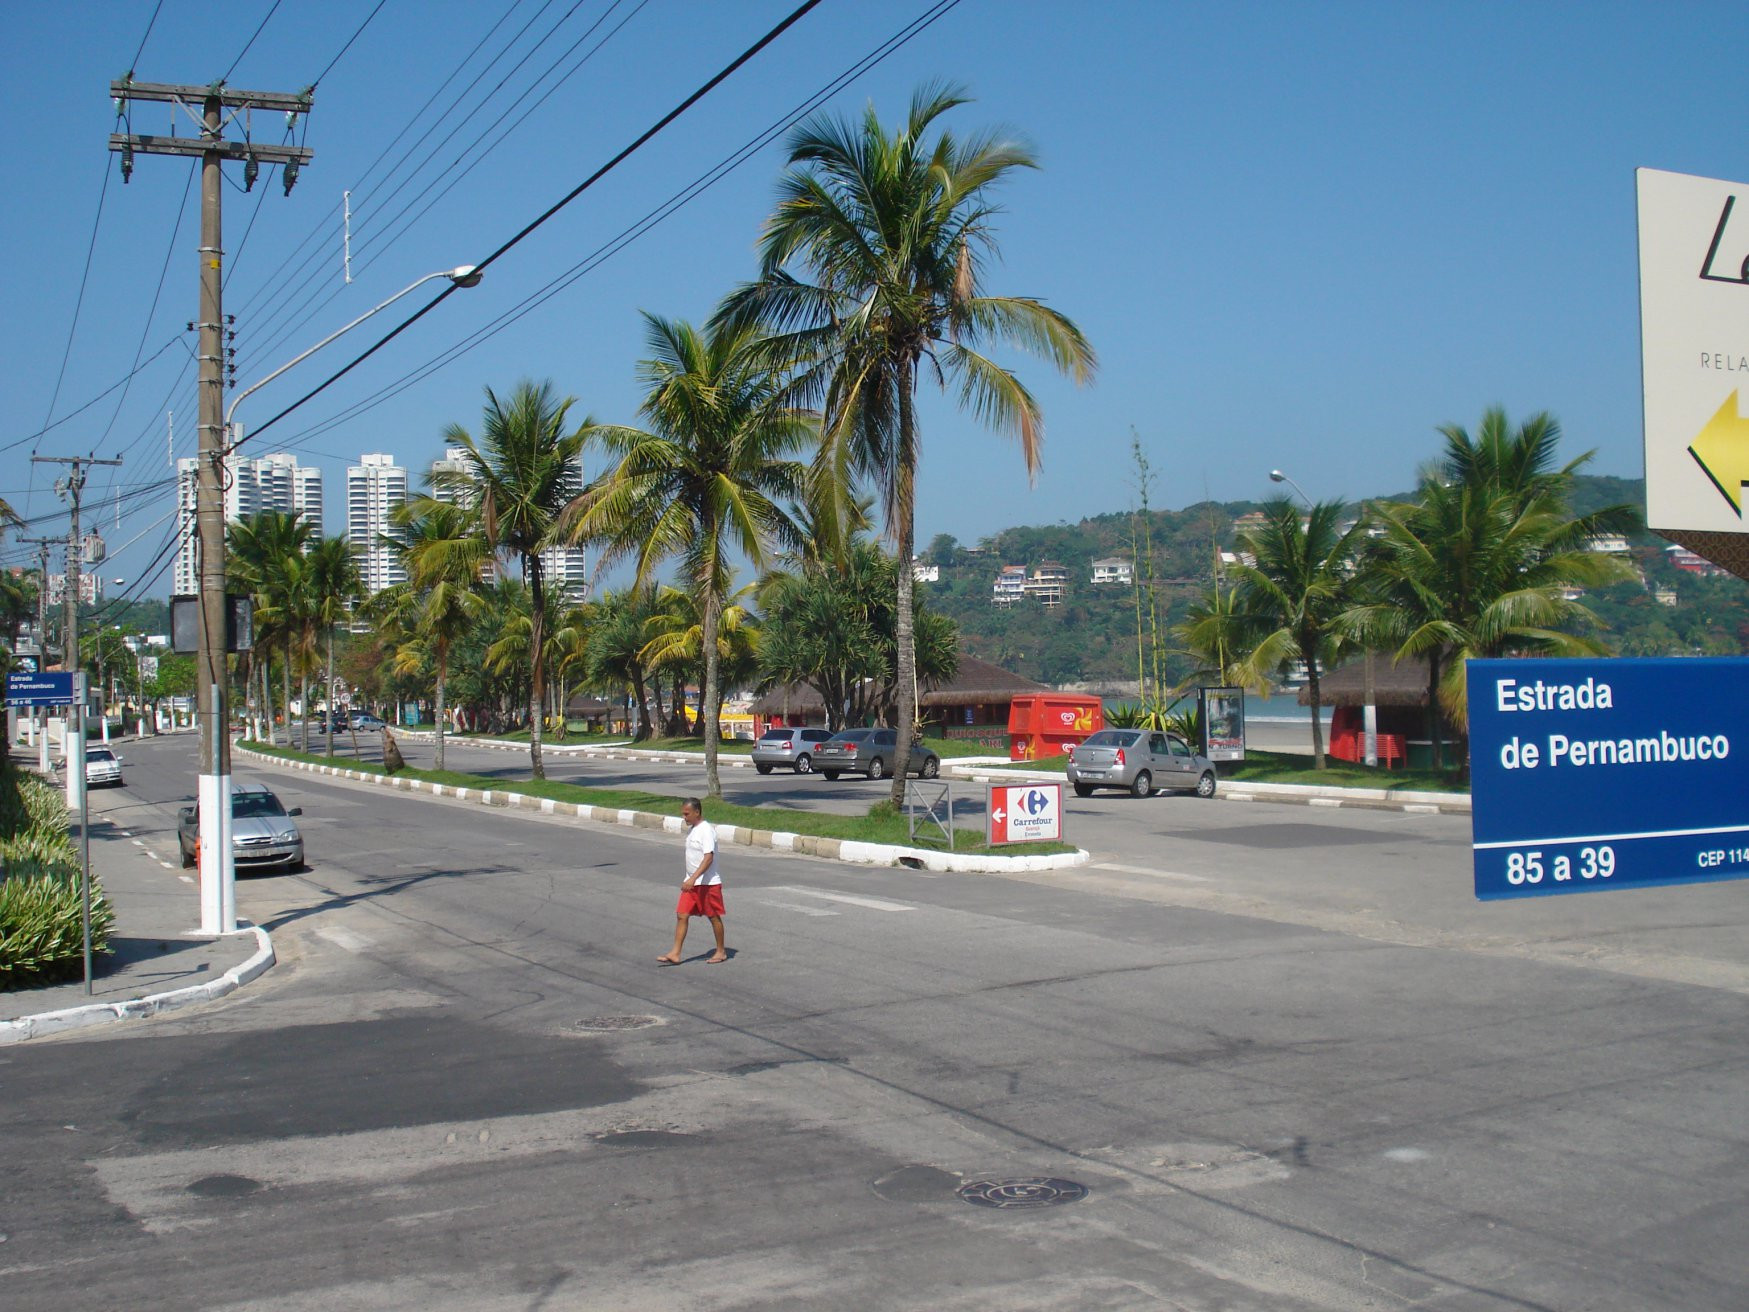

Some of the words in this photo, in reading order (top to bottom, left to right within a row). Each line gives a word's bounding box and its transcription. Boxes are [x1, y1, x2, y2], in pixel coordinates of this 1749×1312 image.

[1701, 352, 1749, 371] RELA
[1497, 677, 1613, 712] Estrada
[1501, 737, 1539, 769] de
[1550, 731, 1729, 767] Pernambuco
[1013, 817, 1053, 827] Carrefour
[1507, 852, 1544, 885] 85
[1554, 855, 1572, 881] a
[1580, 846, 1616, 879] 39
[1698, 850, 1726, 868] CEP
[1729, 848, 1749, 863] 114
